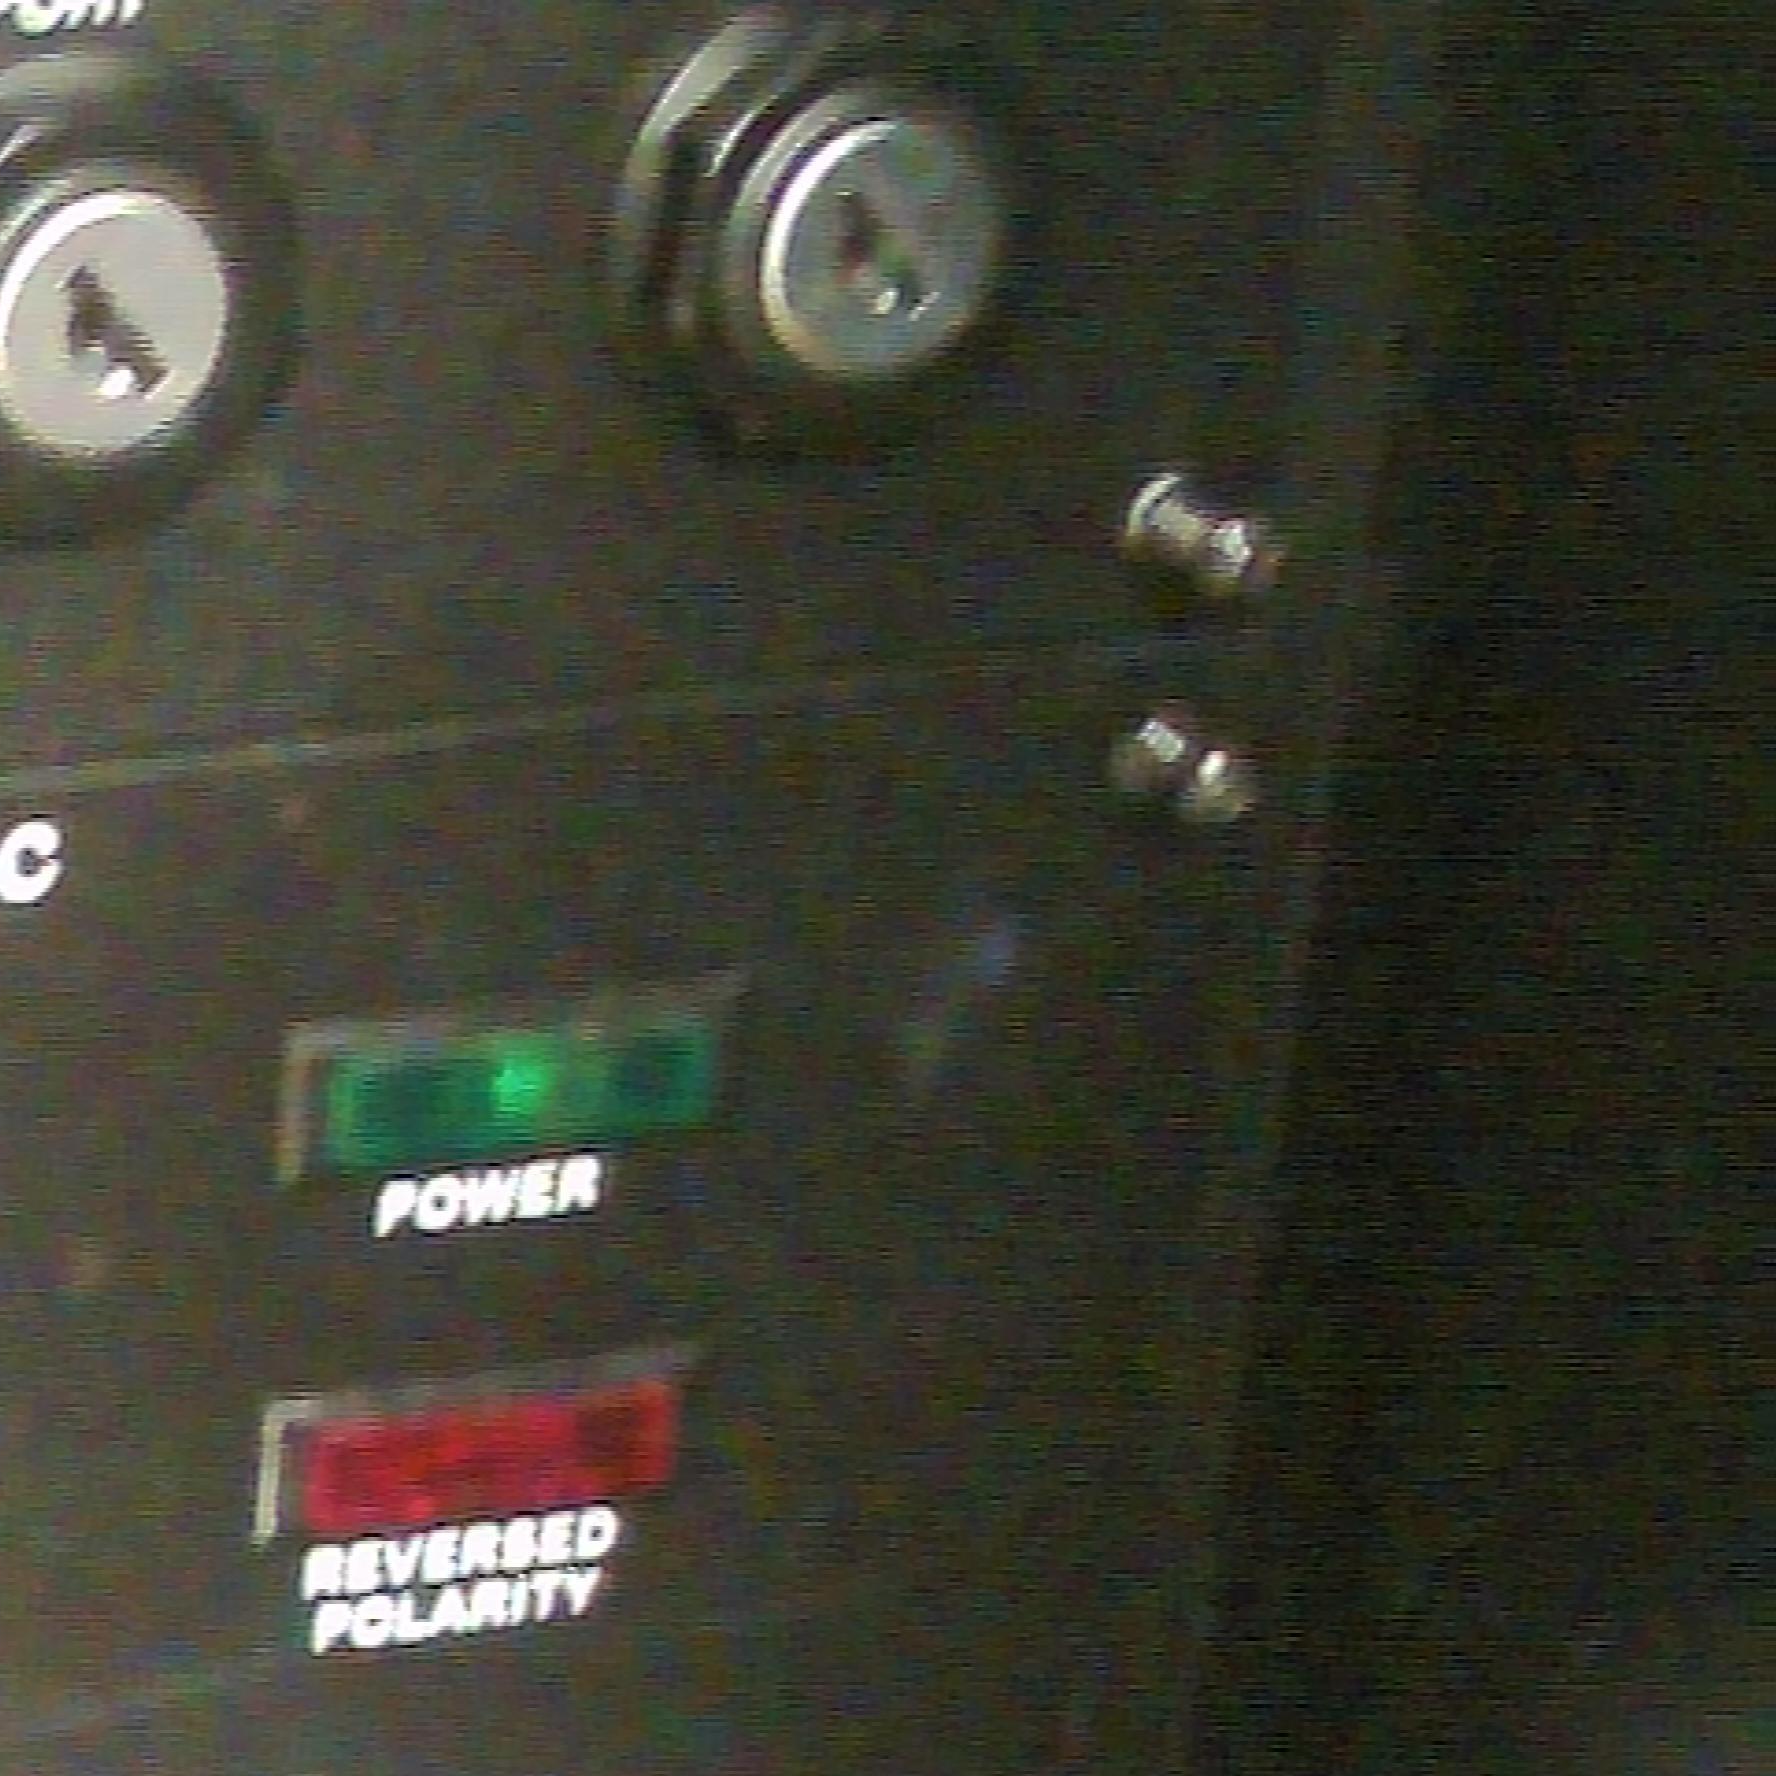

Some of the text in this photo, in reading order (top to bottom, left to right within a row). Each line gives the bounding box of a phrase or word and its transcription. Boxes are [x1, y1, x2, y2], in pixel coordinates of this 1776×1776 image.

[374, 1154, 603, 1238] POWER
[302, 1507, 620, 1598] REVERSED
[310, 1565, 604, 1655] POLARITY
